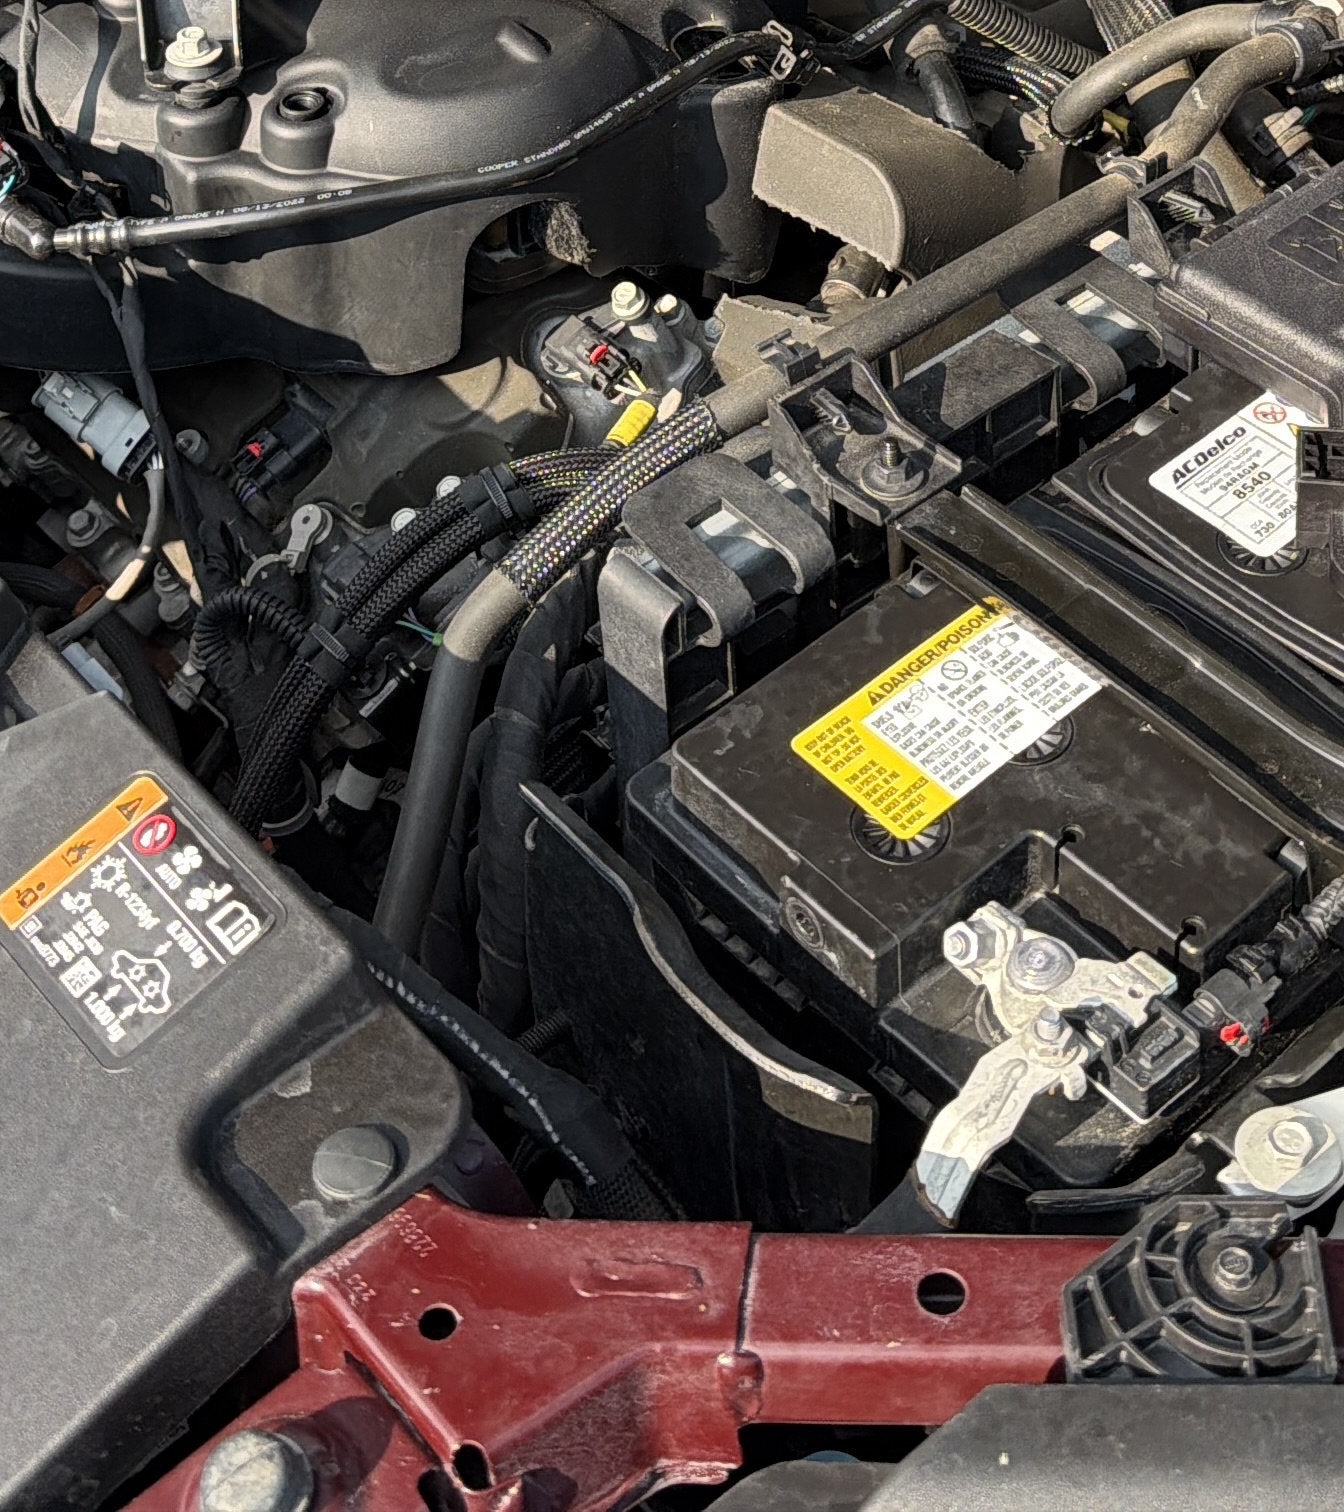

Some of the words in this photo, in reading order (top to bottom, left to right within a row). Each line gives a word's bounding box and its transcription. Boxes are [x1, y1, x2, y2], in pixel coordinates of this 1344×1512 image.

[477, 159, 519, 174] COOPER
[1171, 425, 1247, 485] ACDelco
[1232, 470, 1272, 500] 8540
[1253, 521, 1276, 538] 730
[83, 907, 111, 938] PAG
